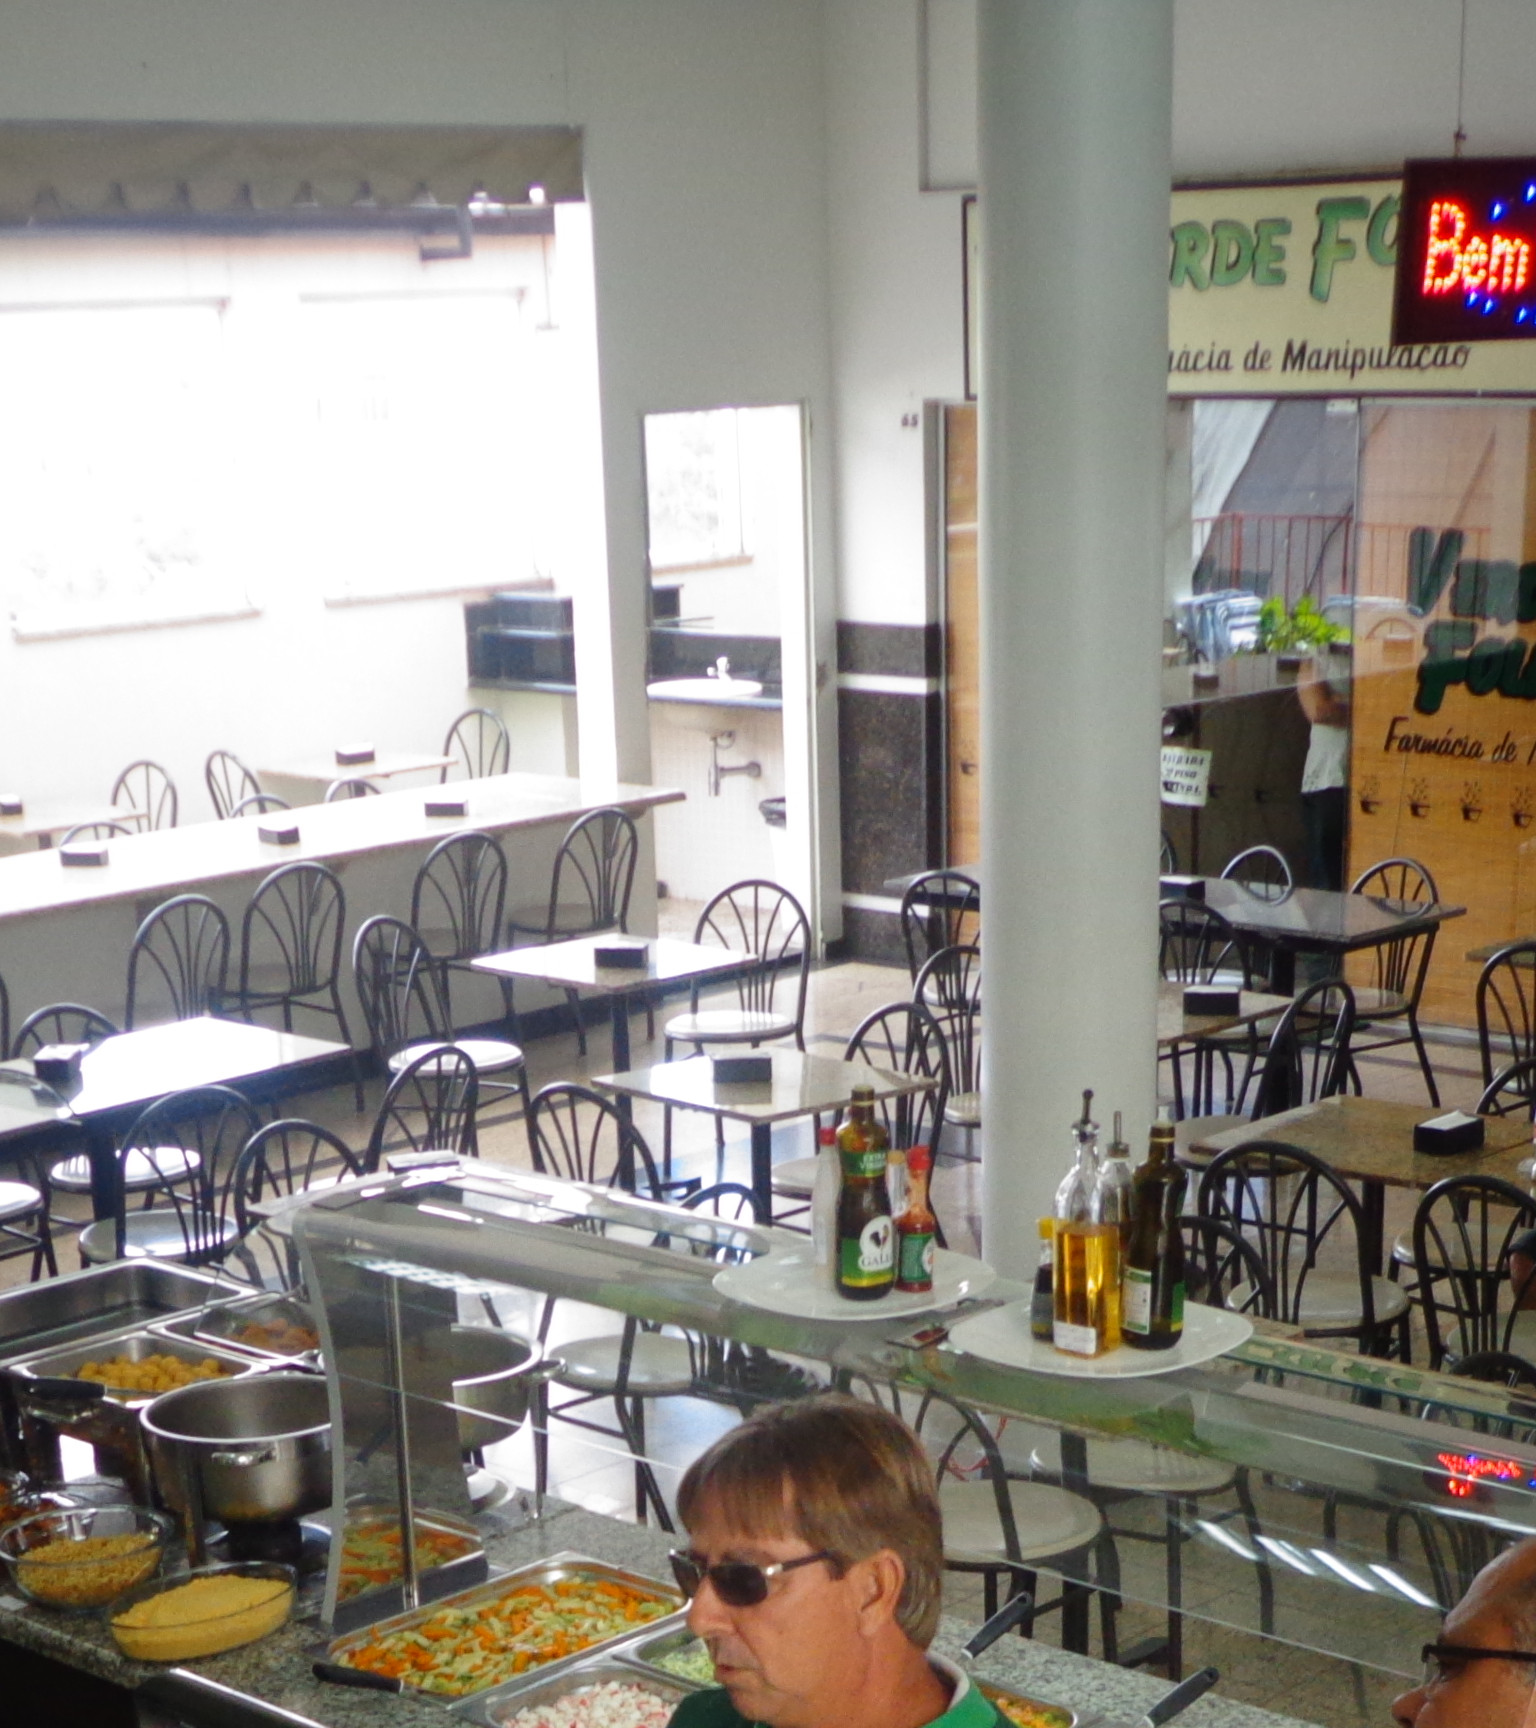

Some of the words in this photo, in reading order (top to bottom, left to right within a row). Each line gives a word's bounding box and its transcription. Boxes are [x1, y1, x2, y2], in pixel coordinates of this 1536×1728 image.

[1169, 217, 1293, 293] RDE
[1421, 200, 1531, 297] Bem
[1243, 340, 1273, 372] de
[1383, 716, 1484, 758] Farmácia
[1491, 731, 1518, 764] de
